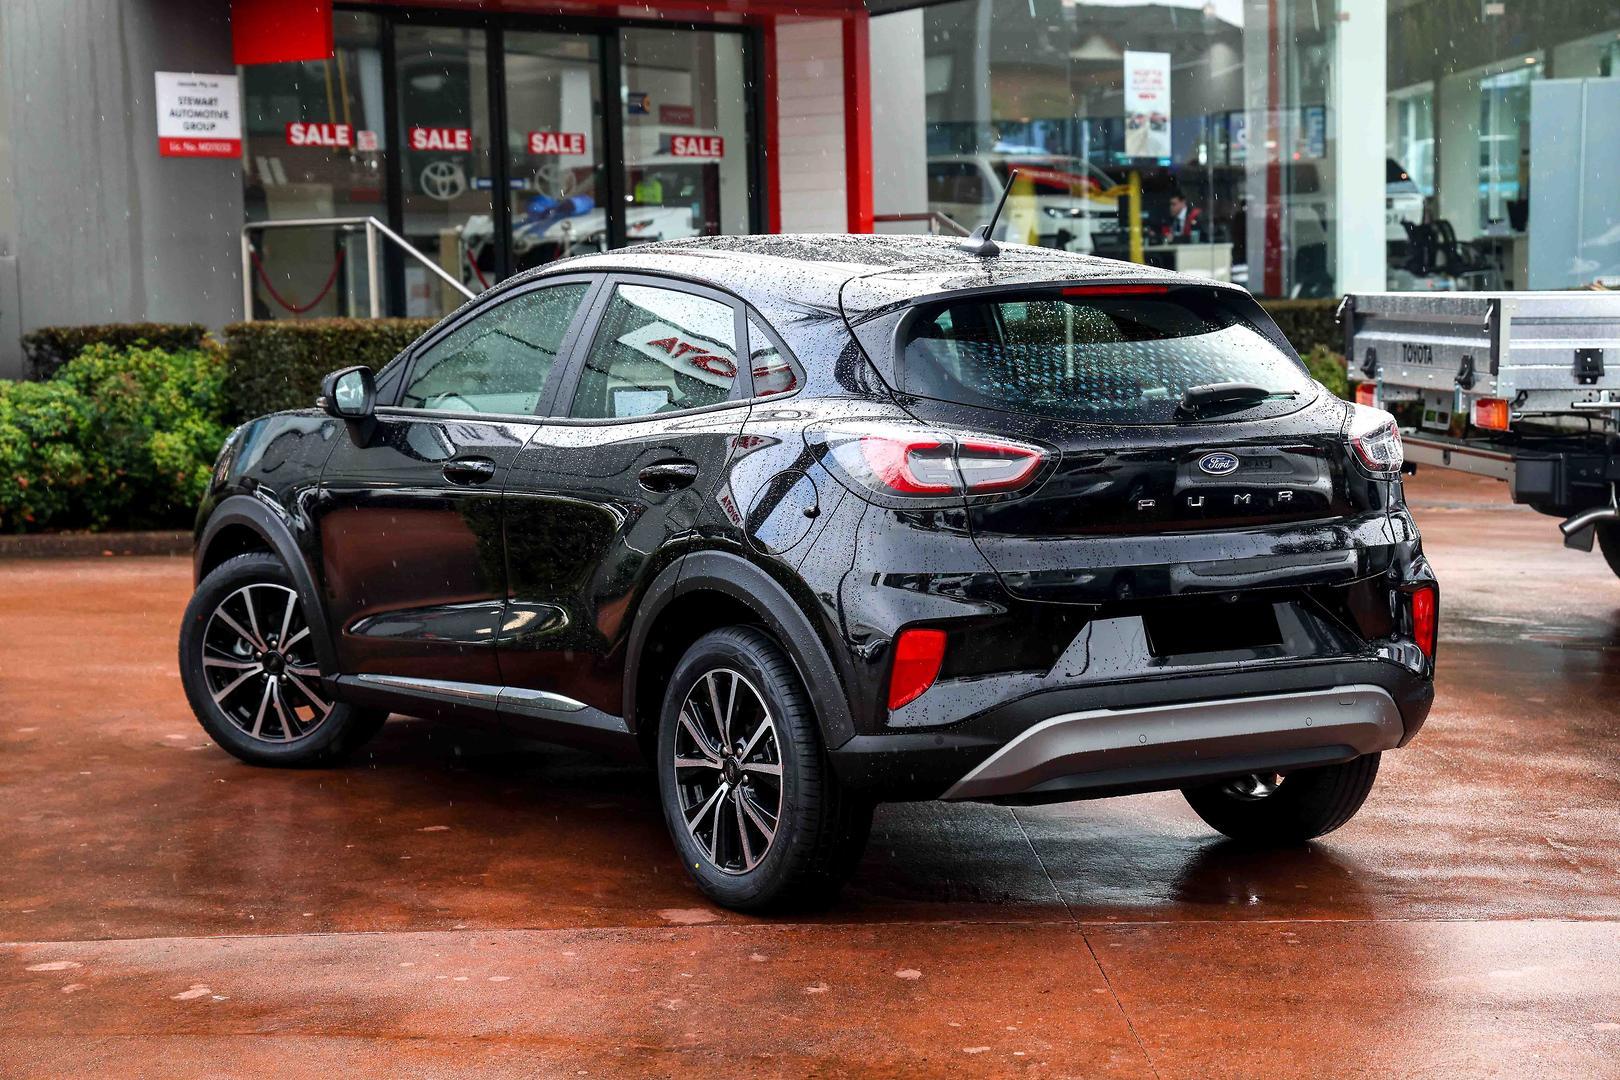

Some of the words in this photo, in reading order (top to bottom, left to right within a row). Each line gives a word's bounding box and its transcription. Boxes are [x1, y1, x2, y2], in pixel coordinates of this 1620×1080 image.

[177, 96, 218, 106] STEWART
[169, 108, 229, 120] AUTOMOTIVE
[183, 121, 216, 131] GROUP
[290, 123, 350, 145] SALE
[413, 128, 468, 150] SALE
[531, 132, 582, 153] SALE
[674, 136, 721, 156] SALE
[1402, 343, 1433, 365] TOYOTA
[1137, 489, 1294, 512] PUMA
